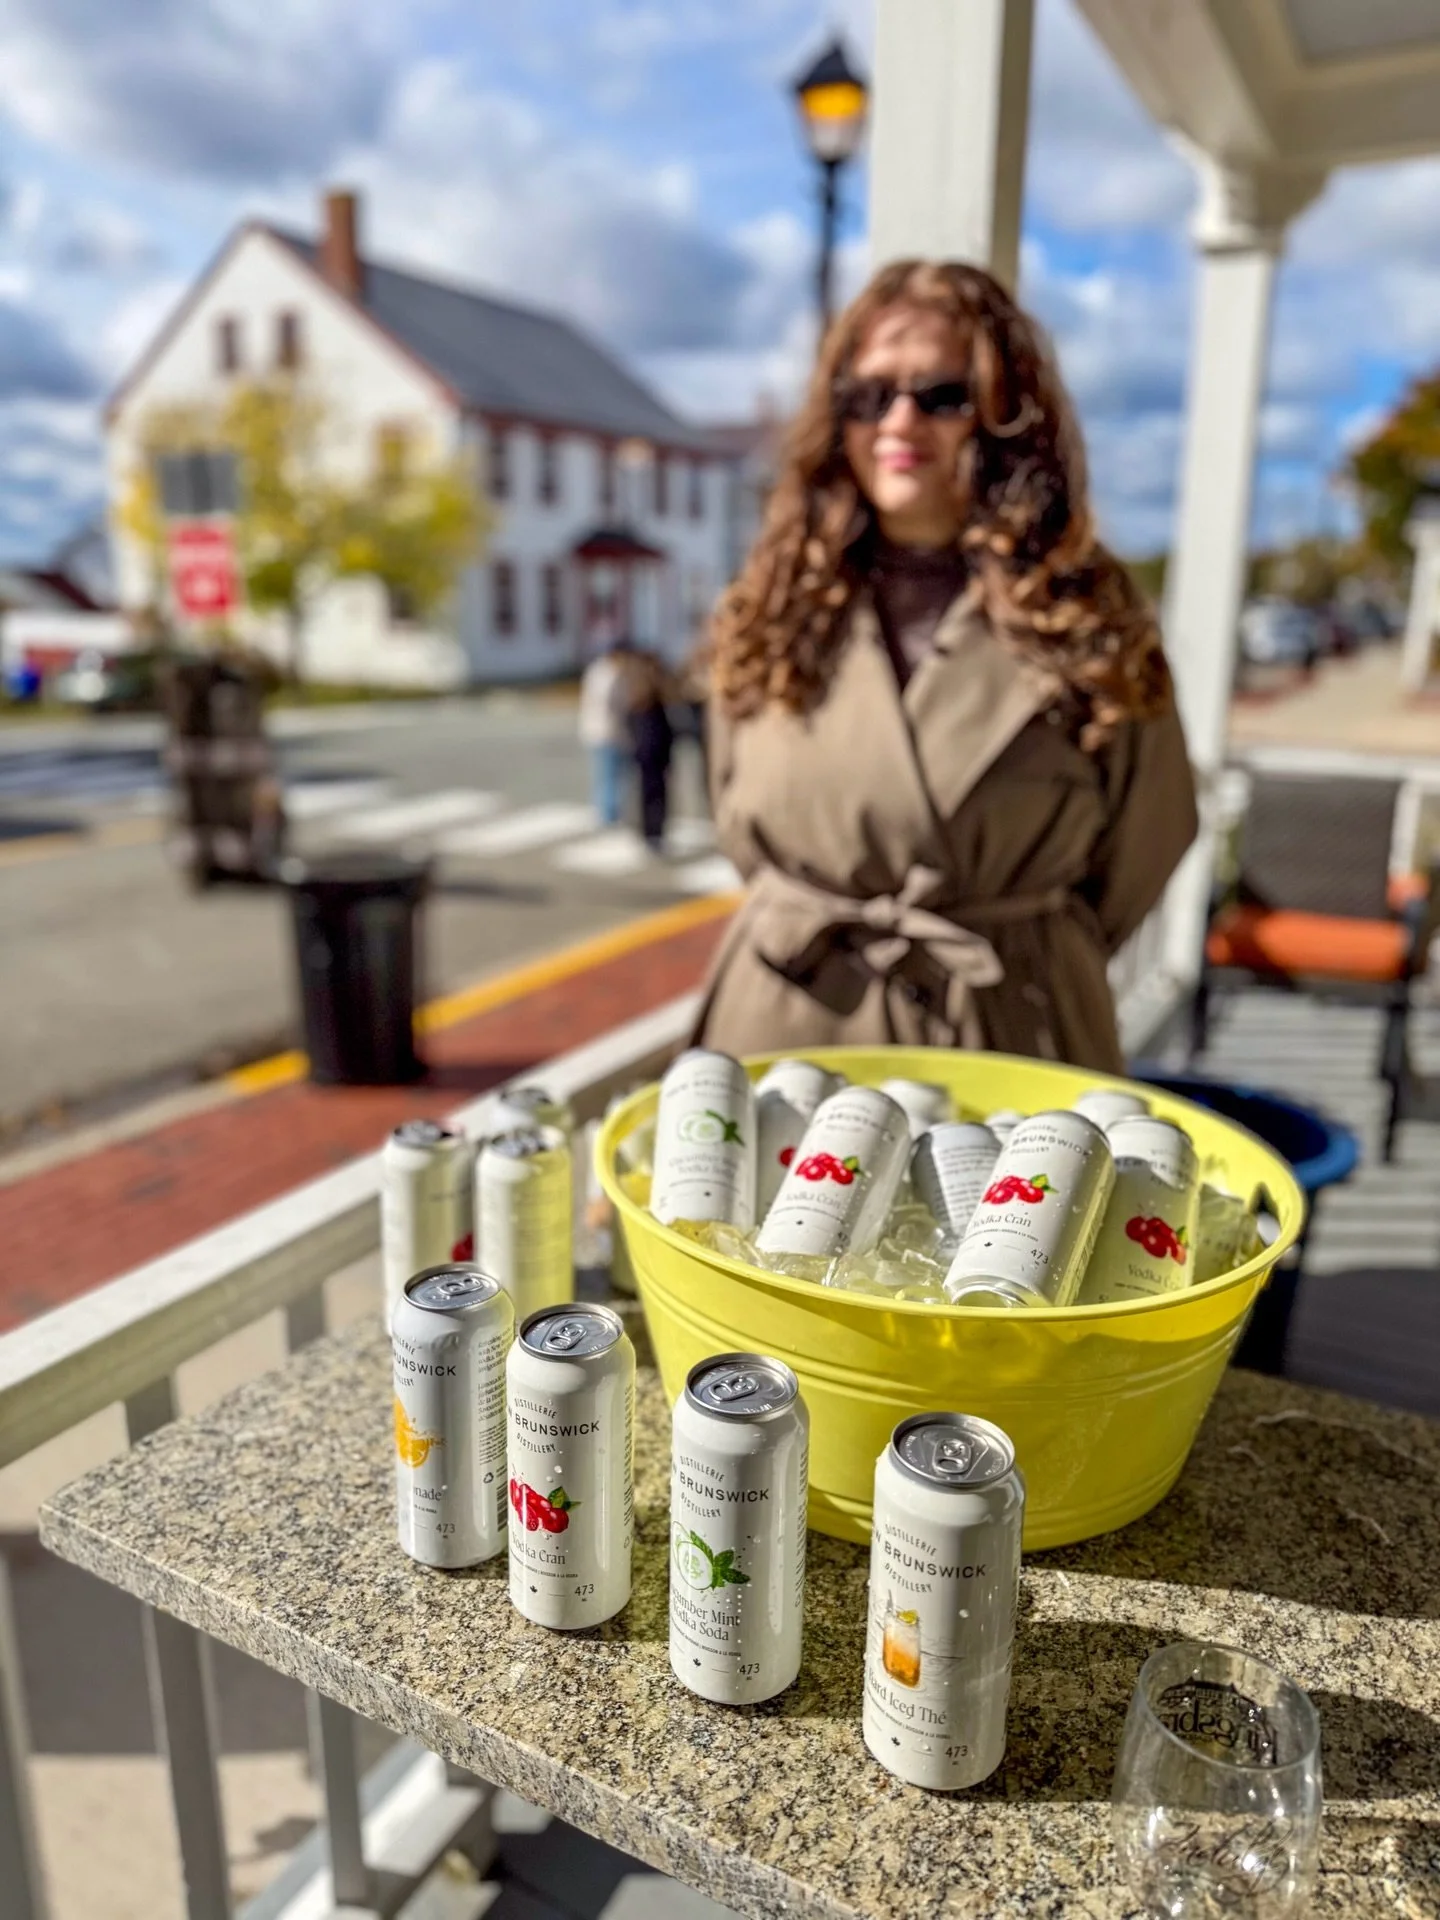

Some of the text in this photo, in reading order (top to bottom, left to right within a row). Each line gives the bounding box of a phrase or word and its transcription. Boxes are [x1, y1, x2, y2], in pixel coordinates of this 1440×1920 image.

[1004, 1212, 1032, 1228] Cran
[1030, 1248, 1049, 1265] 473
[393, 1351, 457, 1377] UNSWICK
[515, 1412, 600, 1437] BRUNSWICK
[516, 1432, 556, 1454] DISTILLERY
[679, 1470, 769, 1503] BRUNSWICK
[681, 1491, 721, 1518] DISTILLERY
[436, 1522, 456, 1534] 473
[538, 1548, 566, 1566] Cran
[884, 1540, 987, 1579] BRUNSWICK
[884, 1562, 934, 1594] DISTILLERY
[574, 1583, 595, 1597] 473
[711, 1609, 741, 1627] Mint
[699, 1620, 729, 1641] Soda
[739, 1663, 760, 1676] 473
[889, 1691, 915, 1720] Iced
[918, 1705, 947, 1725] Thé
[945, 1745, 969, 1759] 473
